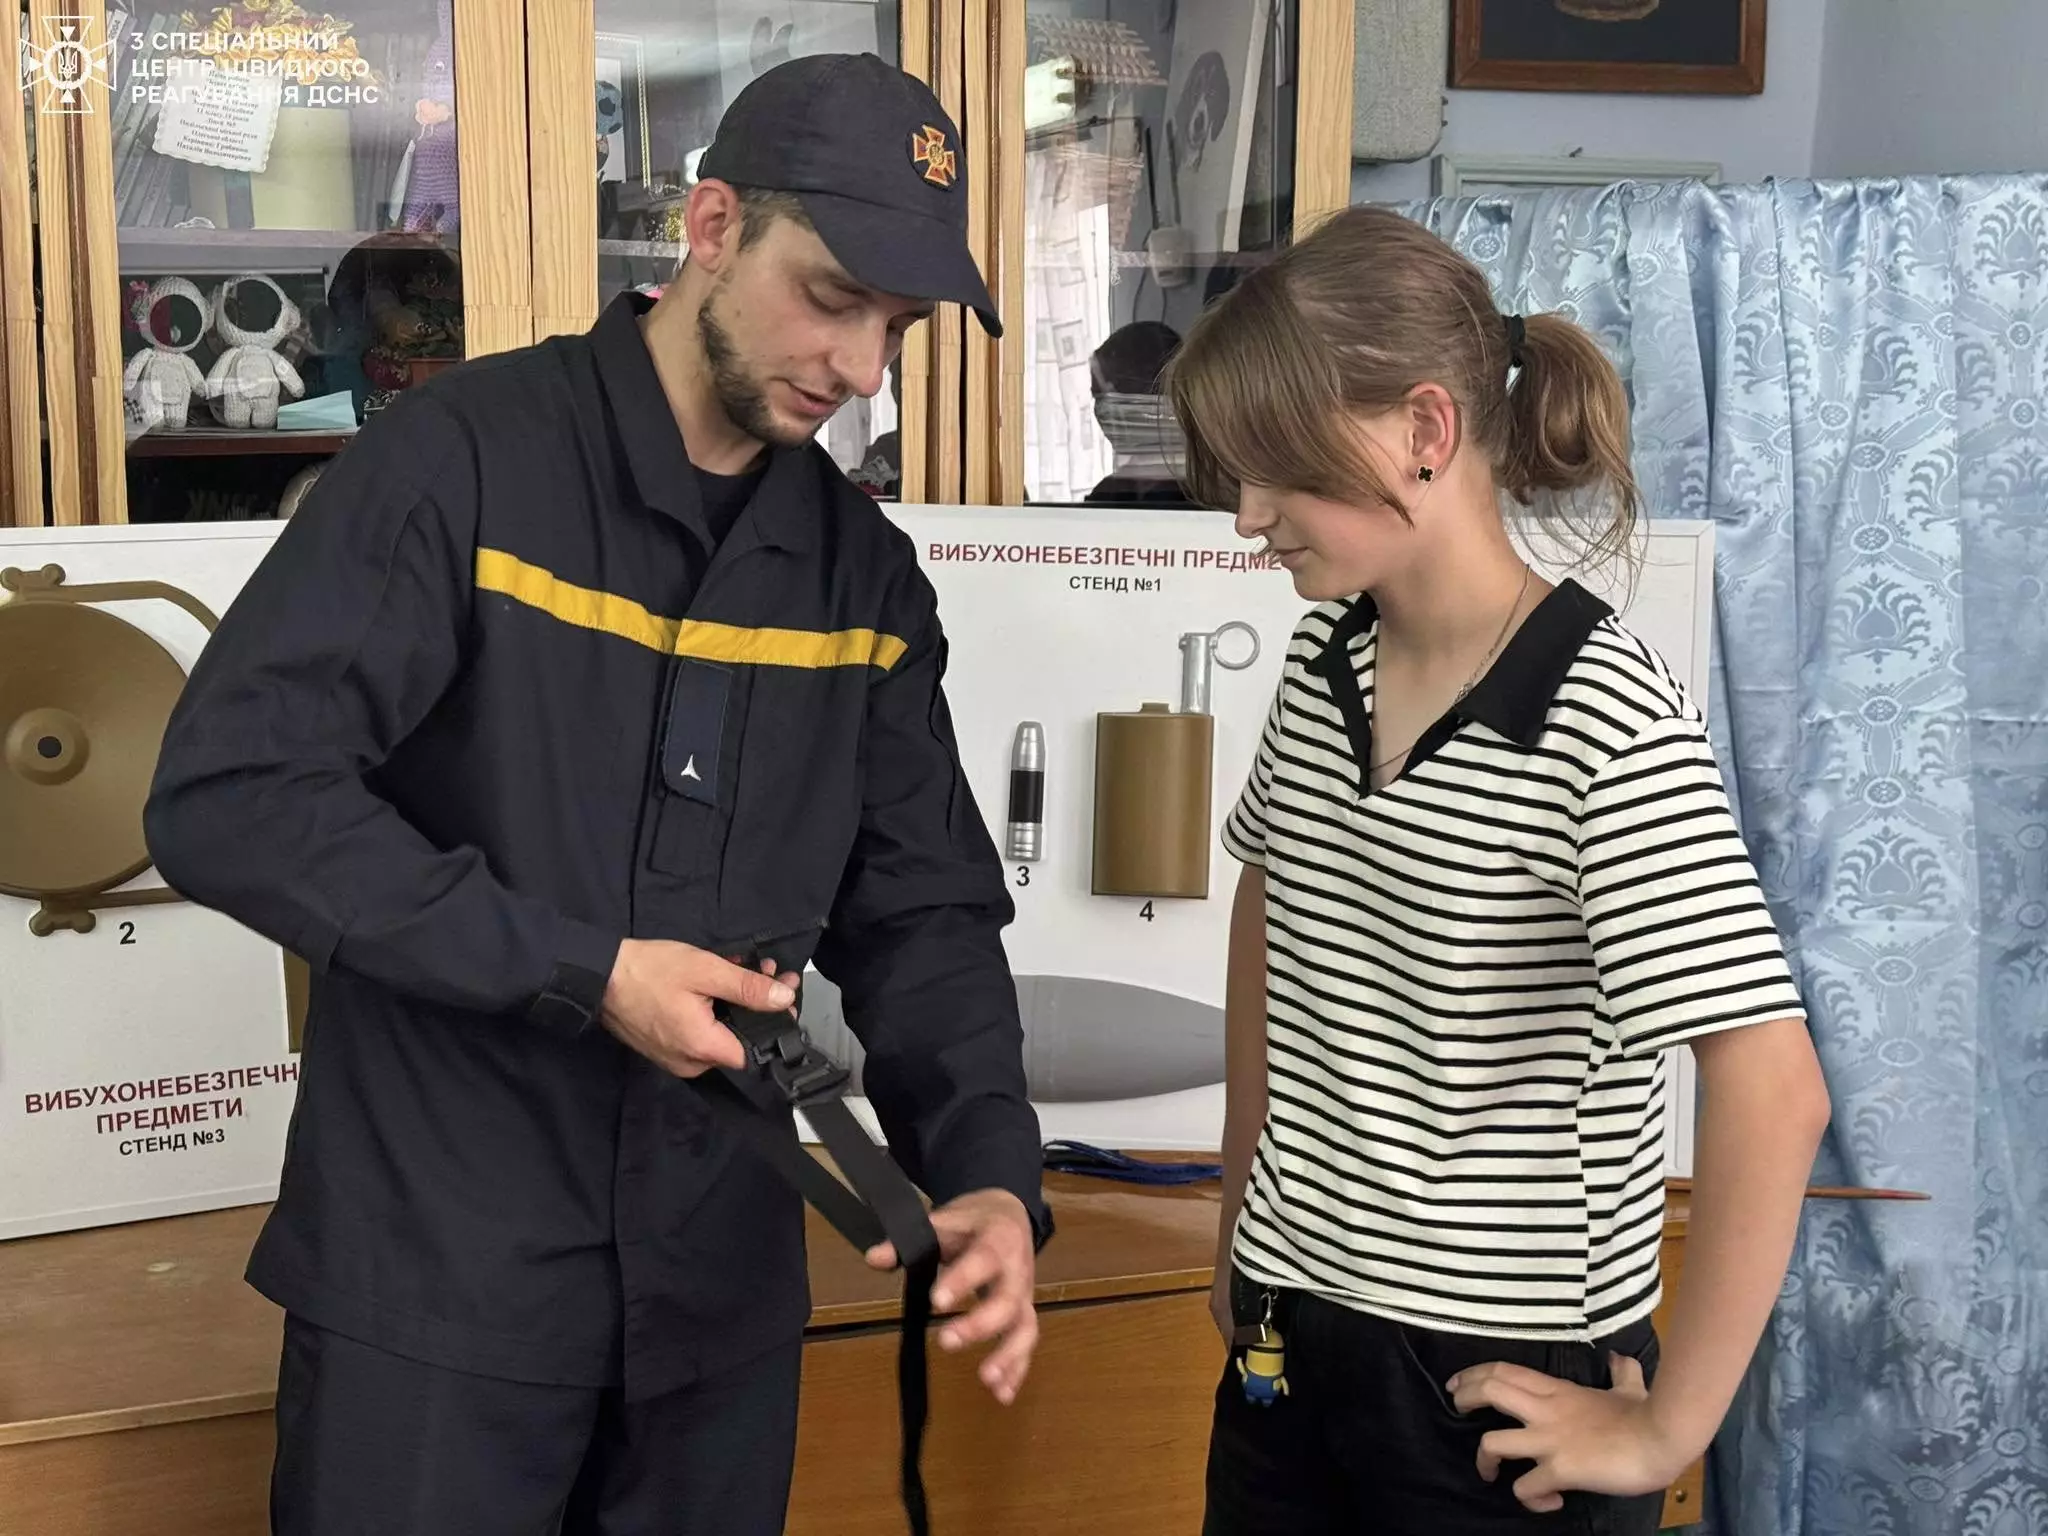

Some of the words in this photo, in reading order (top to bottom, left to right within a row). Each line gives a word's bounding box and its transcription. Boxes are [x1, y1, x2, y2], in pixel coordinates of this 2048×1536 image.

[929, 543, 1176, 568] ВИБУХОНЕБЕЗПЕЧНІ
[1183, 549, 1283, 573] ПРЕДМЕ
[1069, 576, 1129, 593] СТЕНД
[1134, 577, 1163, 592] №1
[1015, 865, 1031, 887] 3
[1138, 900, 1156, 922] 4
[118, 921, 137, 945] 2
[25, 1062, 298, 1115] ВИБУХОНЕБЕЗПЕЧН
[96, 1097, 244, 1134] ПРЕДМЕТИ
[119, 1134, 188, 1156] СТЕНД
[192, 1128, 226, 1151] №3
